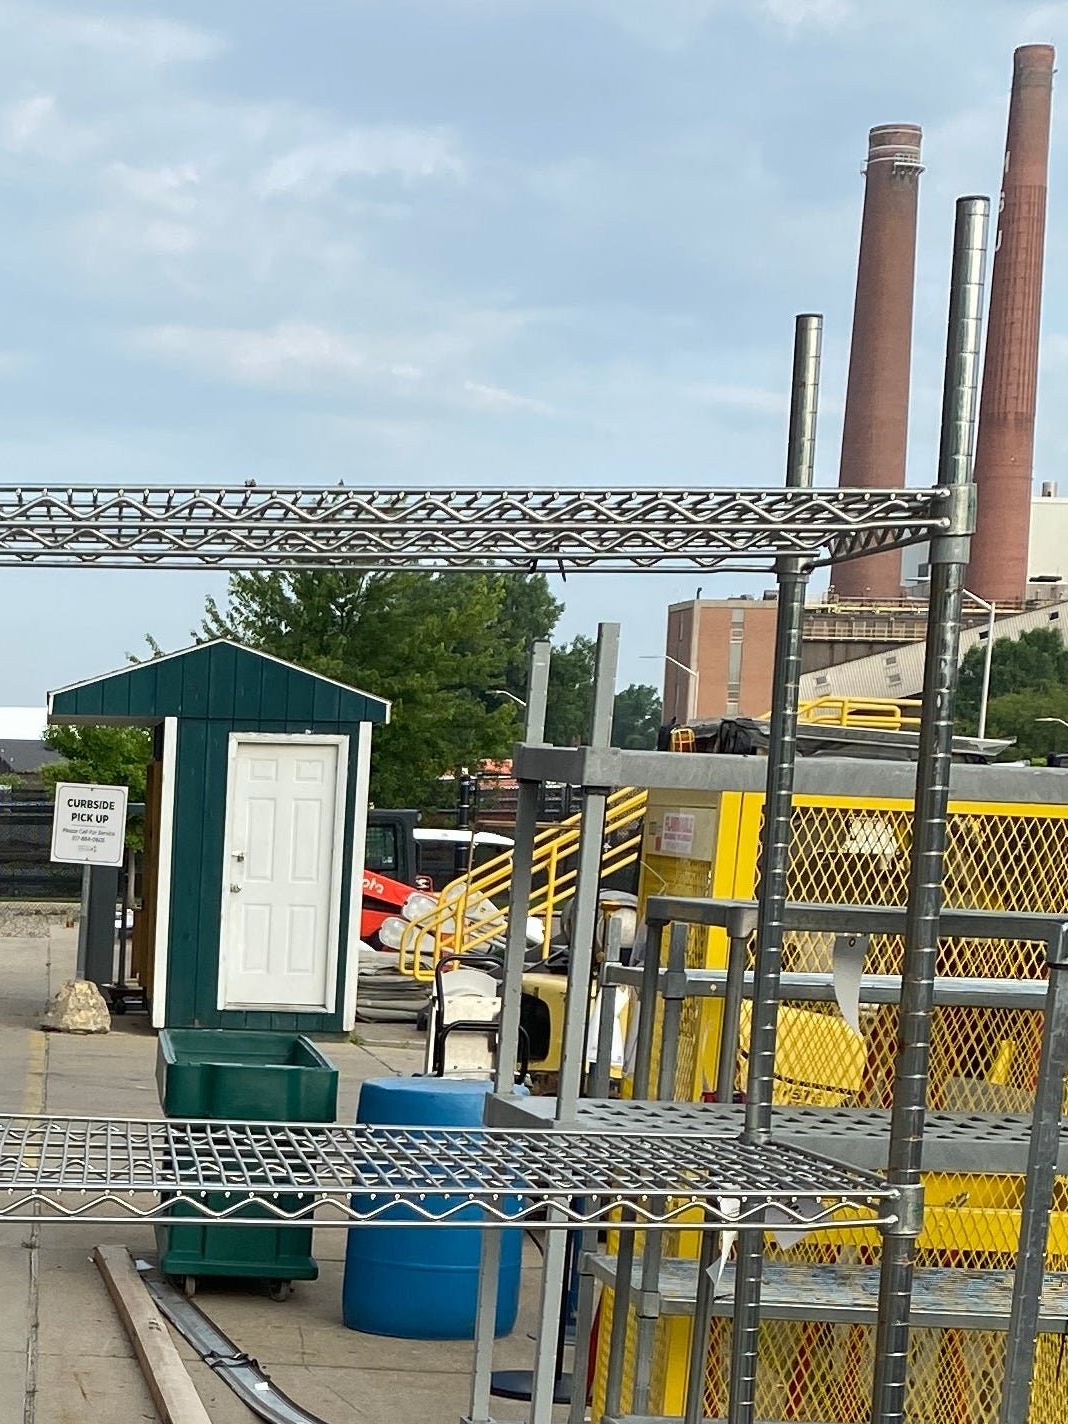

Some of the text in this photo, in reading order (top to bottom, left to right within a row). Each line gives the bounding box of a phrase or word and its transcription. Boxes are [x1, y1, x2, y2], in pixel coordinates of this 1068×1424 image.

[67, 798, 116, 811] CURBSIDE
[71, 812, 109, 824] PICK UP
